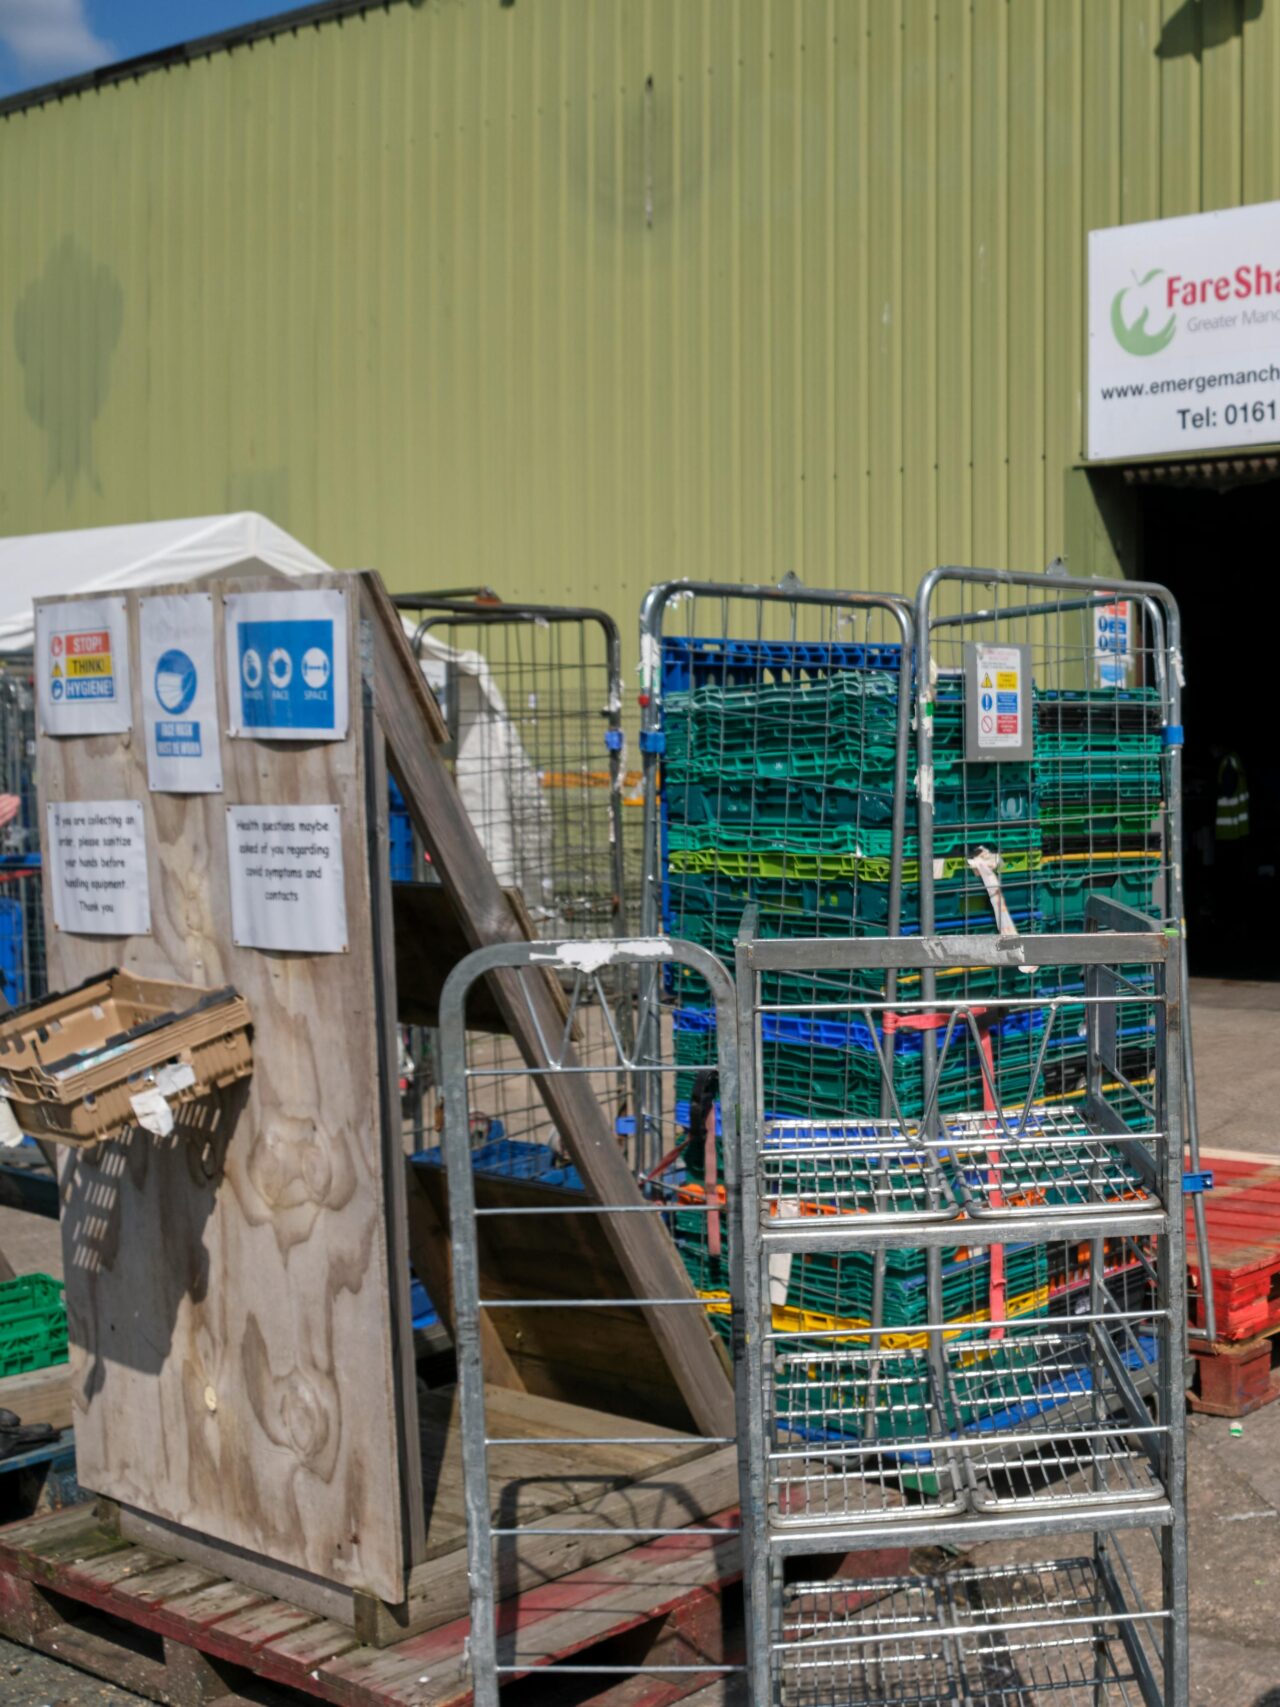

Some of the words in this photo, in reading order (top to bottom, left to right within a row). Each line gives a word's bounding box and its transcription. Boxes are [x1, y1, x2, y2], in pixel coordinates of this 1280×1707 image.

[1186, 314, 1237, 333] Greater
[1178, 407, 1217, 430] Tel:
[1225, 400, 1277, 426] 0161
[304, 690, 328, 700] SPACE
[88, 814, 122, 829] collecting
[287, 843, 329, 859] regarding
[306, 866, 321, 878] and
